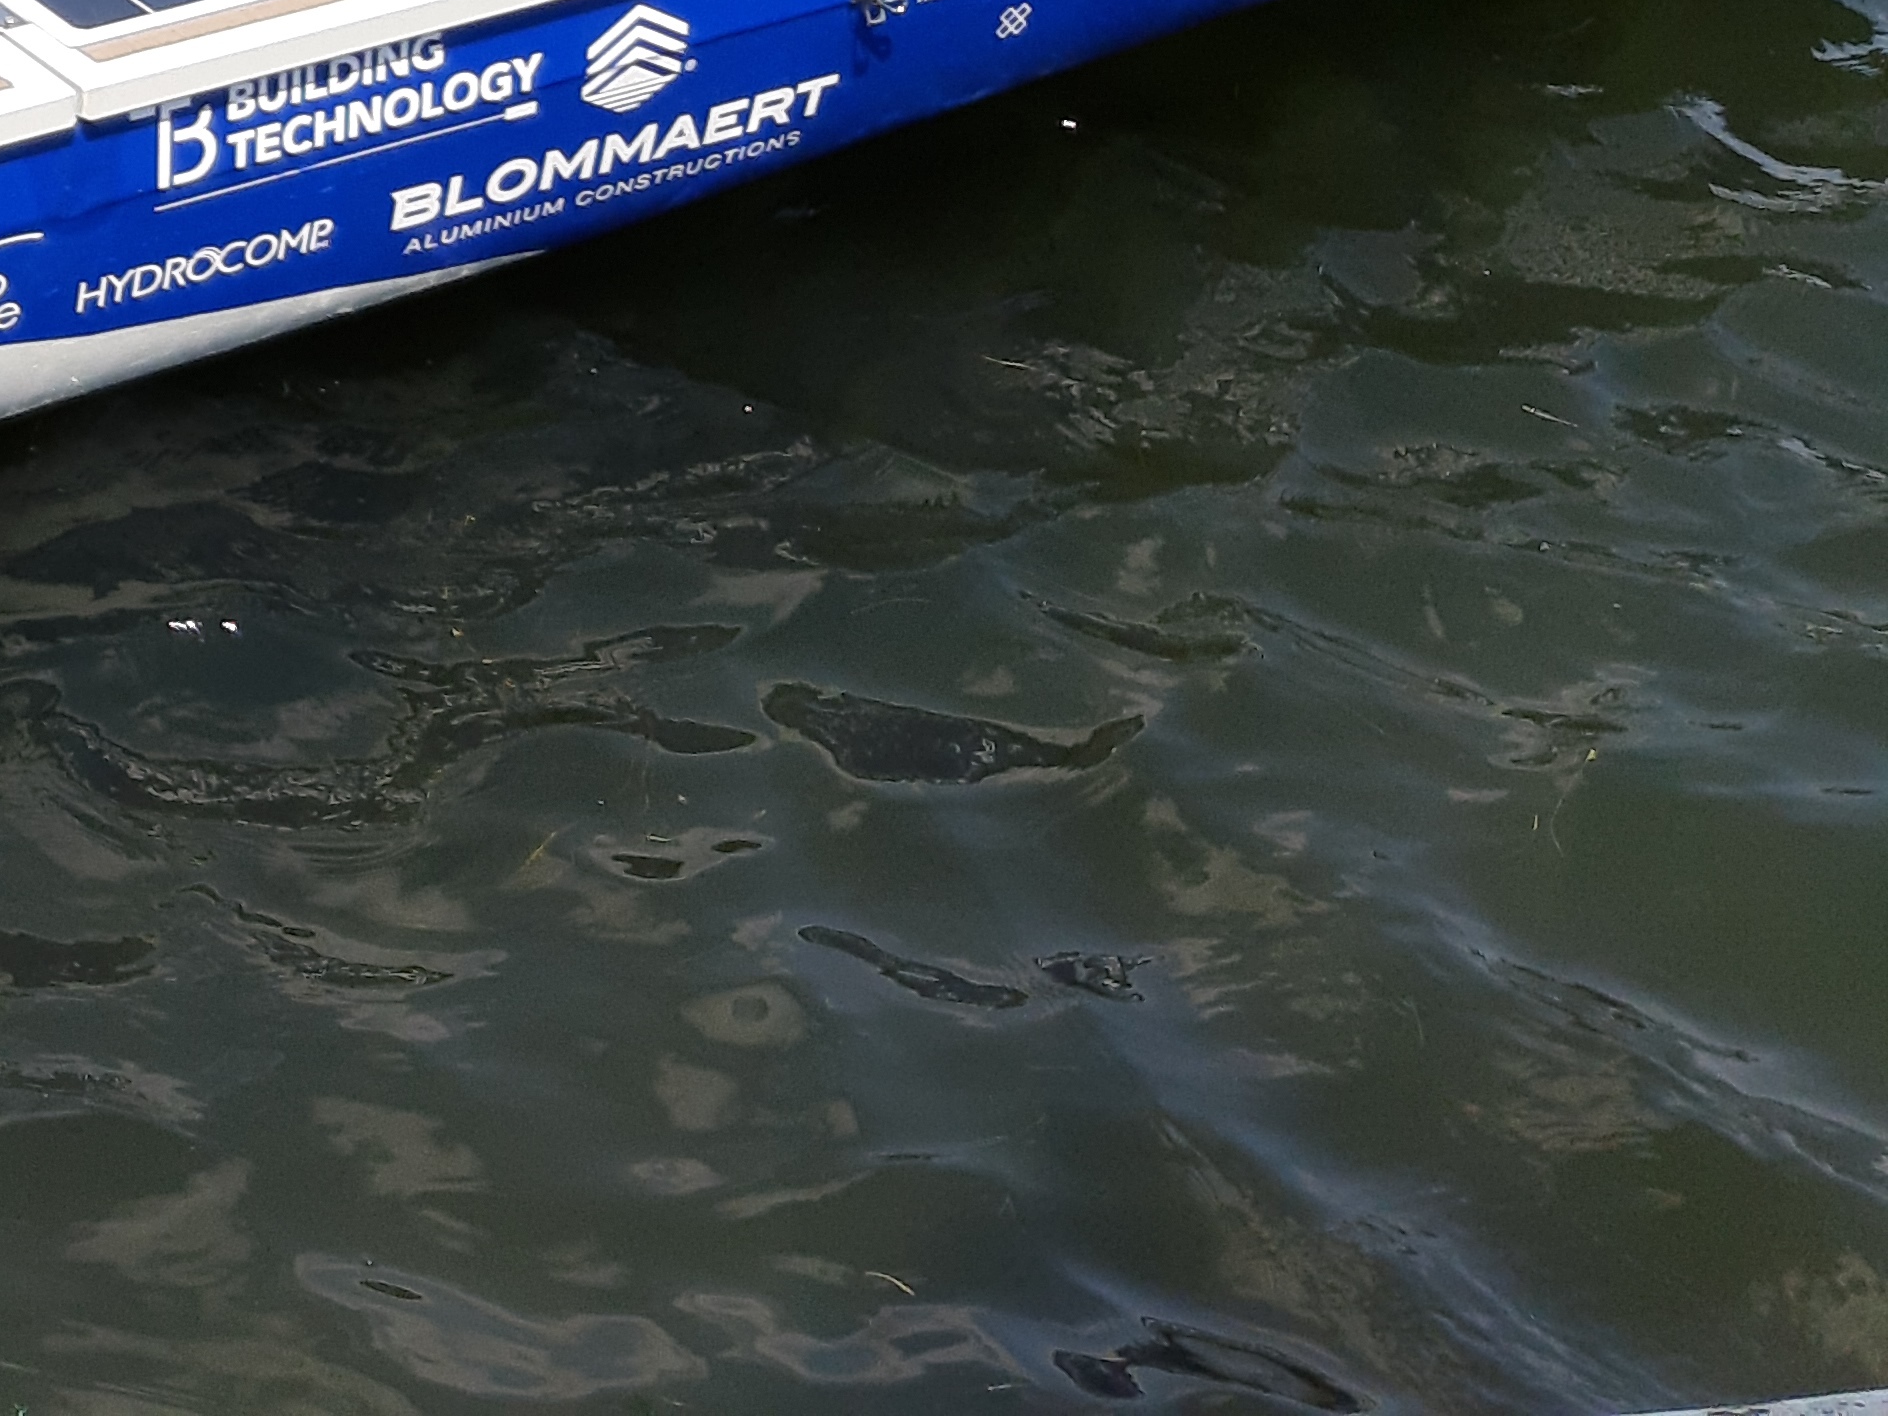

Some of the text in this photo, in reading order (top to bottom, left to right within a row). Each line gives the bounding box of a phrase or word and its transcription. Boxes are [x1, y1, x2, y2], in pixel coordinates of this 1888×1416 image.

[226, 32, 445, 123] BUILDING
[226, 52, 545, 171] TECHNOLOGY
[390, 73, 842, 232] BLOMMAERT
[402, 129, 802, 256] ALUMINIUM CONSTRUCTIONS
[75, 218, 336, 314] HYDROCOMP
